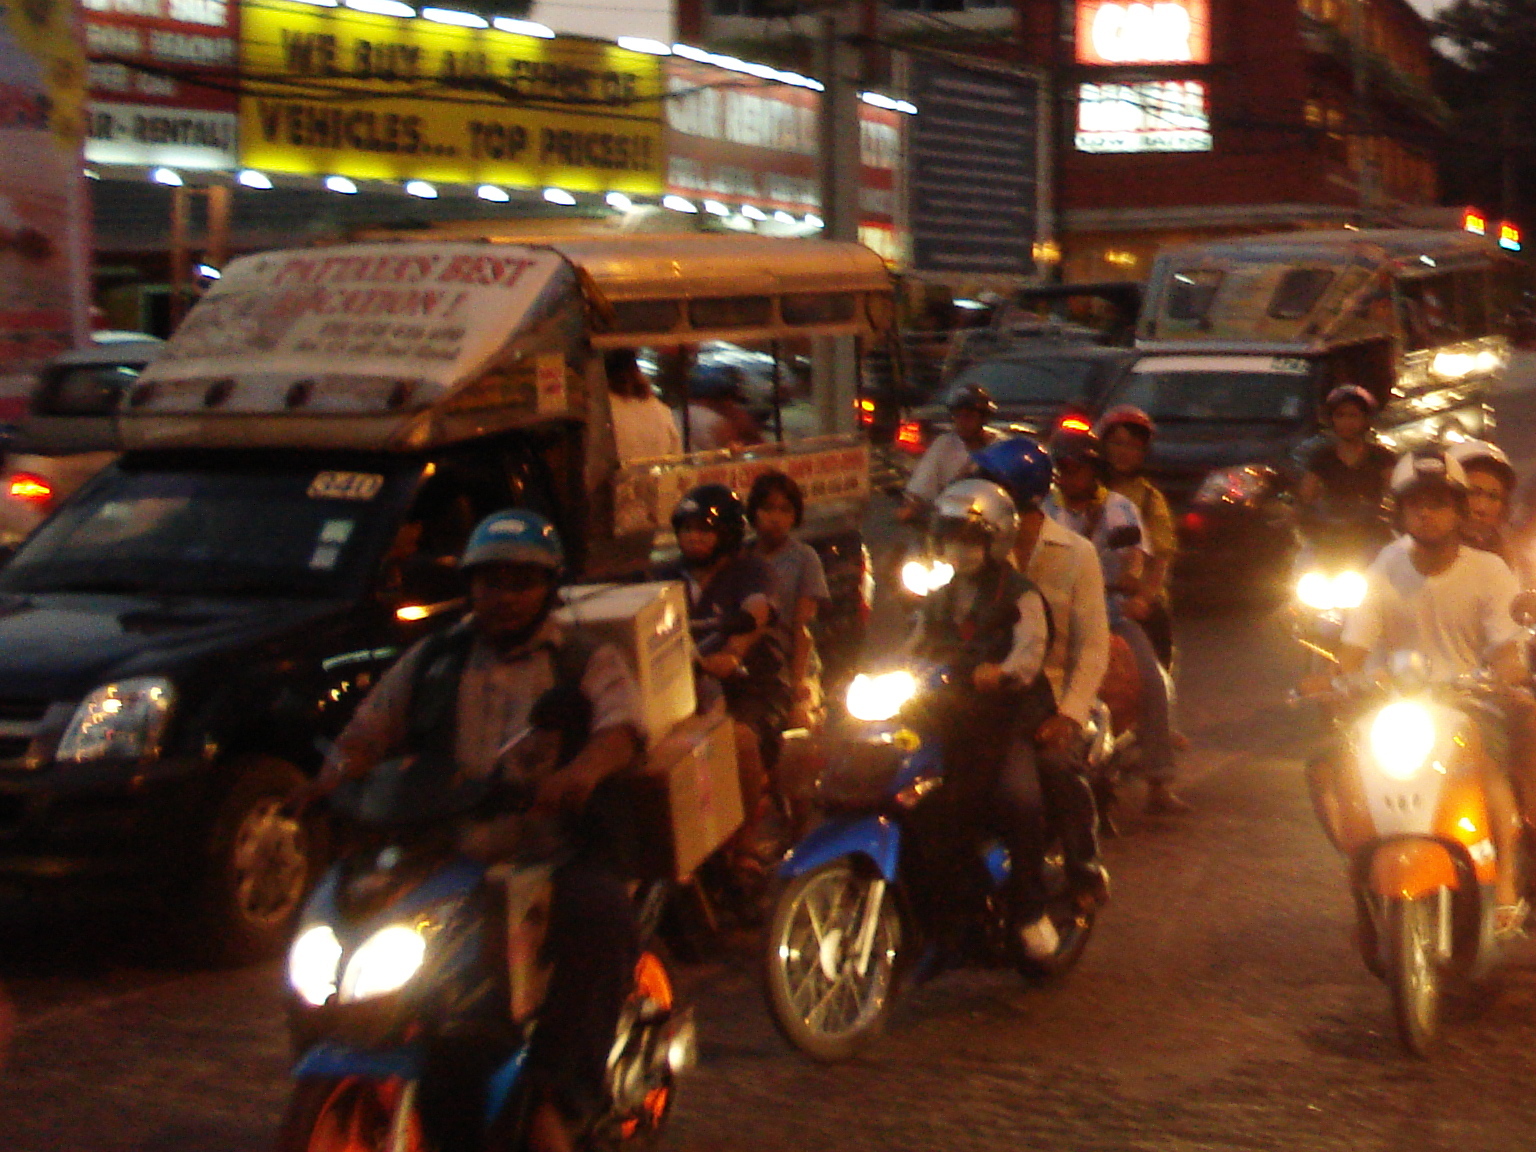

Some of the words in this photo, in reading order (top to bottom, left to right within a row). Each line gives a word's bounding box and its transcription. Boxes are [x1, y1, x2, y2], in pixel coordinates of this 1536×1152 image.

[281, 28, 337, 76] WE
[355, 38, 420, 81] BUY
[467, 119, 529, 161] TOP
[439, 255, 536, 287] BEST
